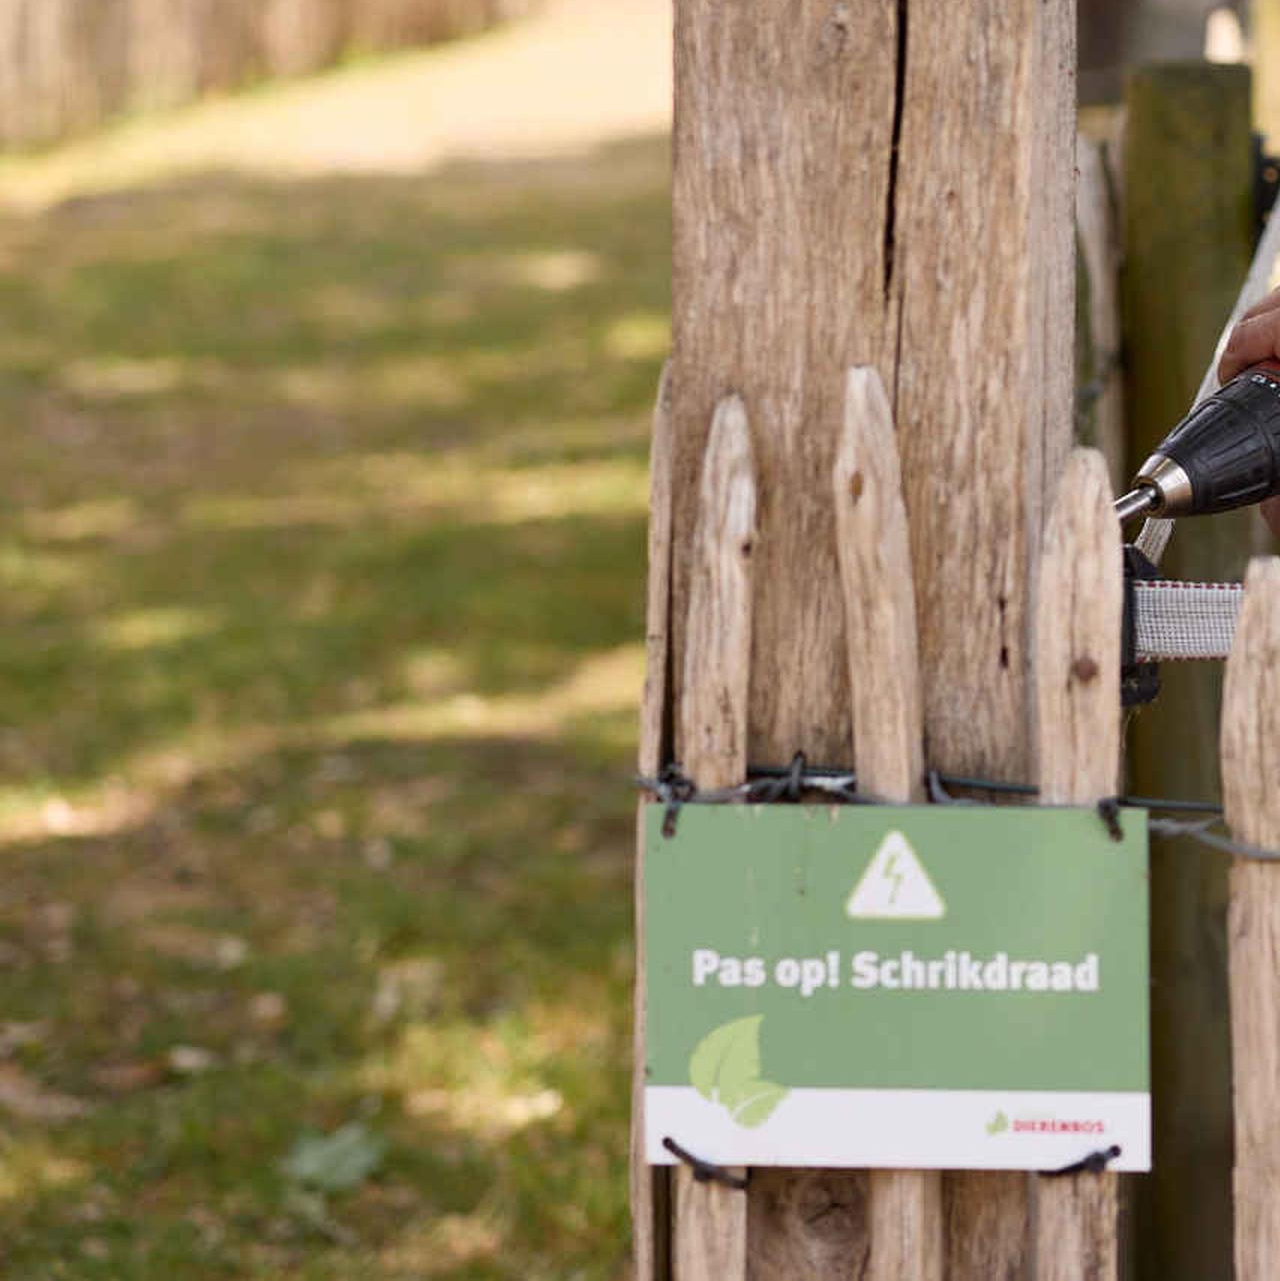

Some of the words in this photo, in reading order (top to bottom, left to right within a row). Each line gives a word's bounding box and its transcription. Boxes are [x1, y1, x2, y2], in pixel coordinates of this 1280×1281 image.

[691, 948, 767, 987] Pas
[774, 950, 841, 998] op!
[850, 950, 1101, 993] Schrikdraad
